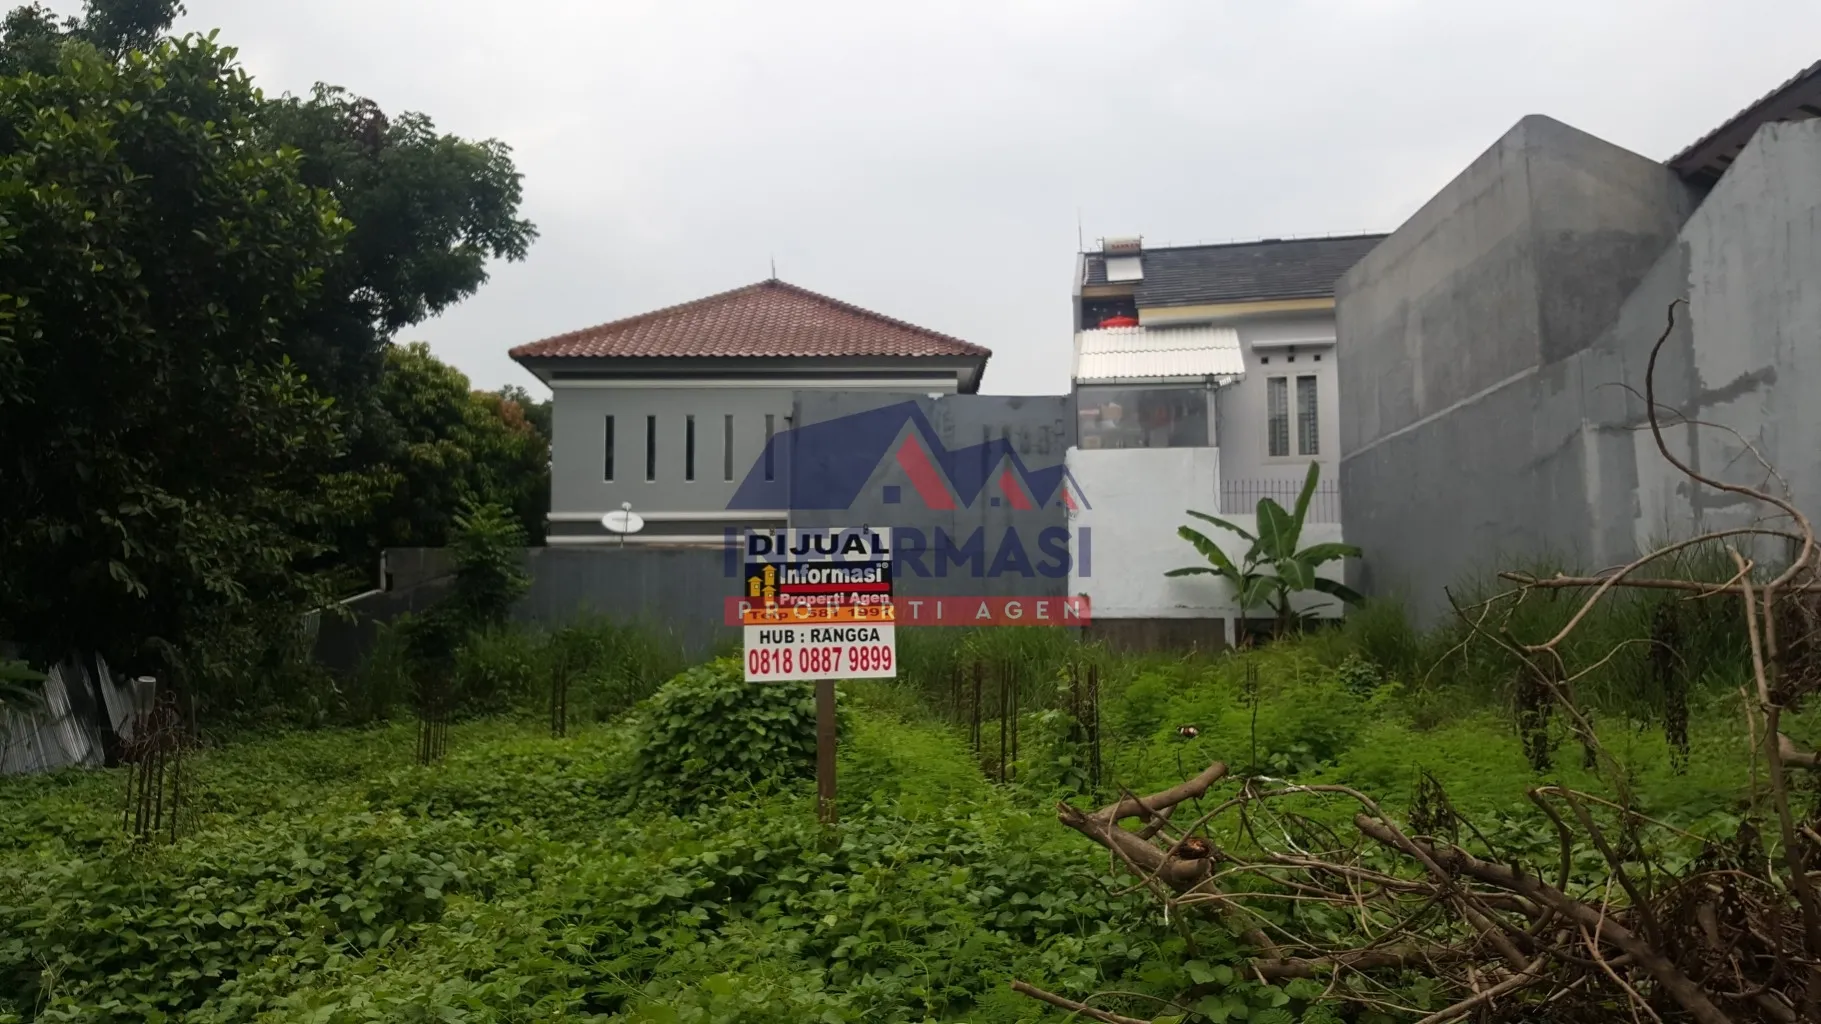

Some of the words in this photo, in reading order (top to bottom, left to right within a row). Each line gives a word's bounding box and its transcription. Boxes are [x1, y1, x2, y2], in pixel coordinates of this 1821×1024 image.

[749, 534, 889, 555] DIJUAL
[780, 593, 844, 605] Properti
[850, 593, 889, 605] Agen
[760, 630, 794, 644] HUB
[811, 628, 880, 642] RANGGA
[749, 648, 792, 674] 0818
[800, 647, 842, 672] 0887
[849, 645, 891, 671] 9899
